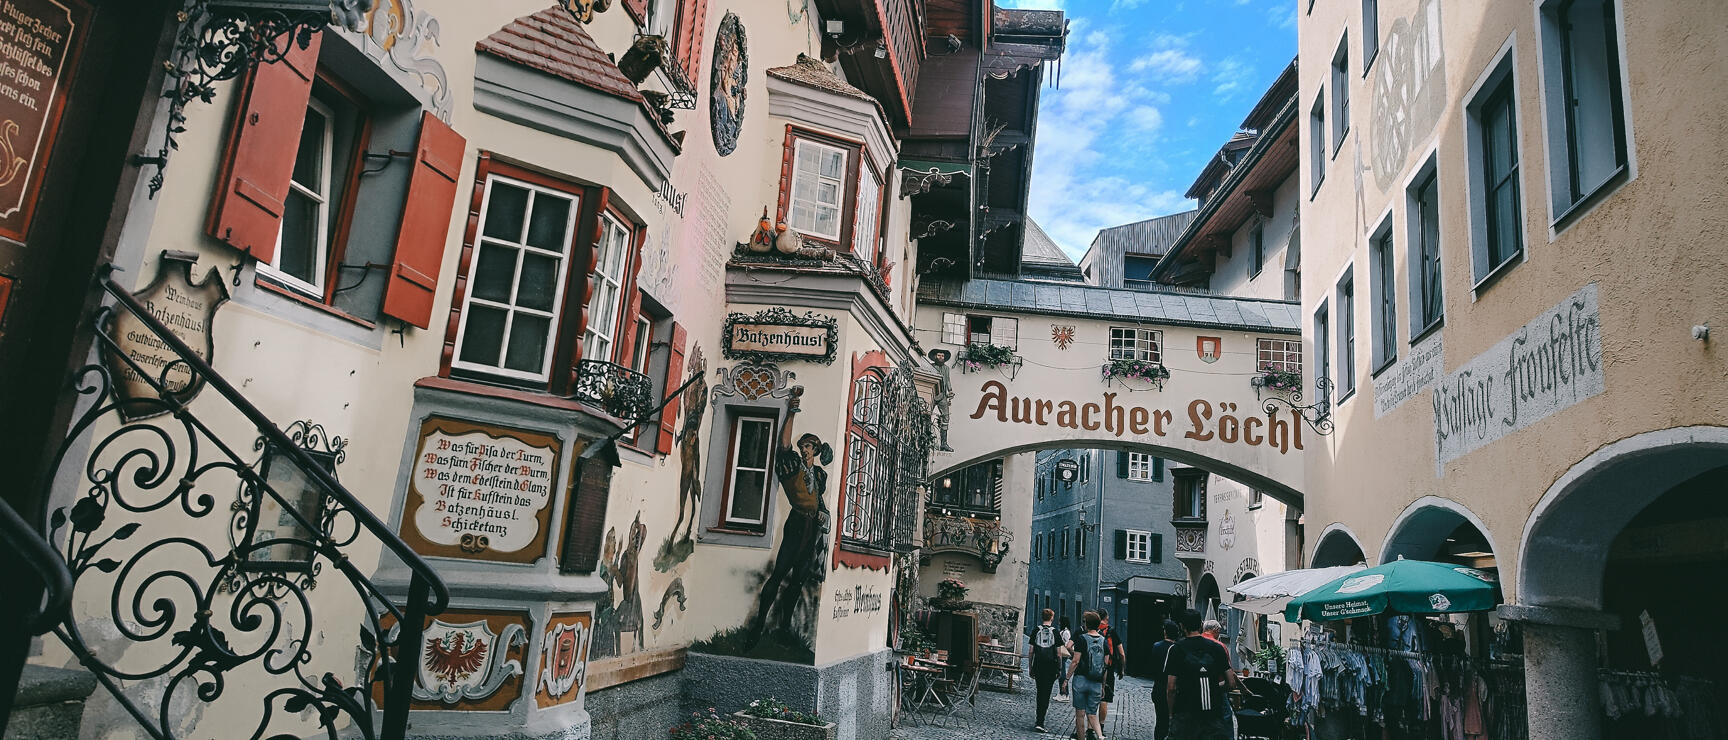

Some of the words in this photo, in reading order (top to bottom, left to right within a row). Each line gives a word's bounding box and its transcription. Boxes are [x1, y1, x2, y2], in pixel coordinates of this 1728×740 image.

[36, 58, 52, 77] des
[0, 82, 19, 101] ens
[736, 326, 825, 348] Batzenhäusl
[969, 379, 1173, 438] Auracher
[1184, 399, 1304, 455] Löchl
[437, 438, 464, 452] Was
[465, 441, 479, 455] für
[478, 444, 498, 458] Pisa
[500, 447, 516, 459] der
[515, 449, 545, 466] Turm,
[424, 452, 449, 466] Was
[469, 457, 503, 473] Fischer
[504, 463, 520, 475] der
[519, 465, 550, 481] Wurm,
[424, 468, 451, 482] Was
[452, 471, 472, 484] dem
[471, 473, 512, 490] Edelstein
[519, 479, 548, 497] Glanz
[438, 483, 455, 498] Ist
[457, 488, 473, 501] für
[473, 488, 513, 506] Kufstein
[513, 494, 531, 508] das
